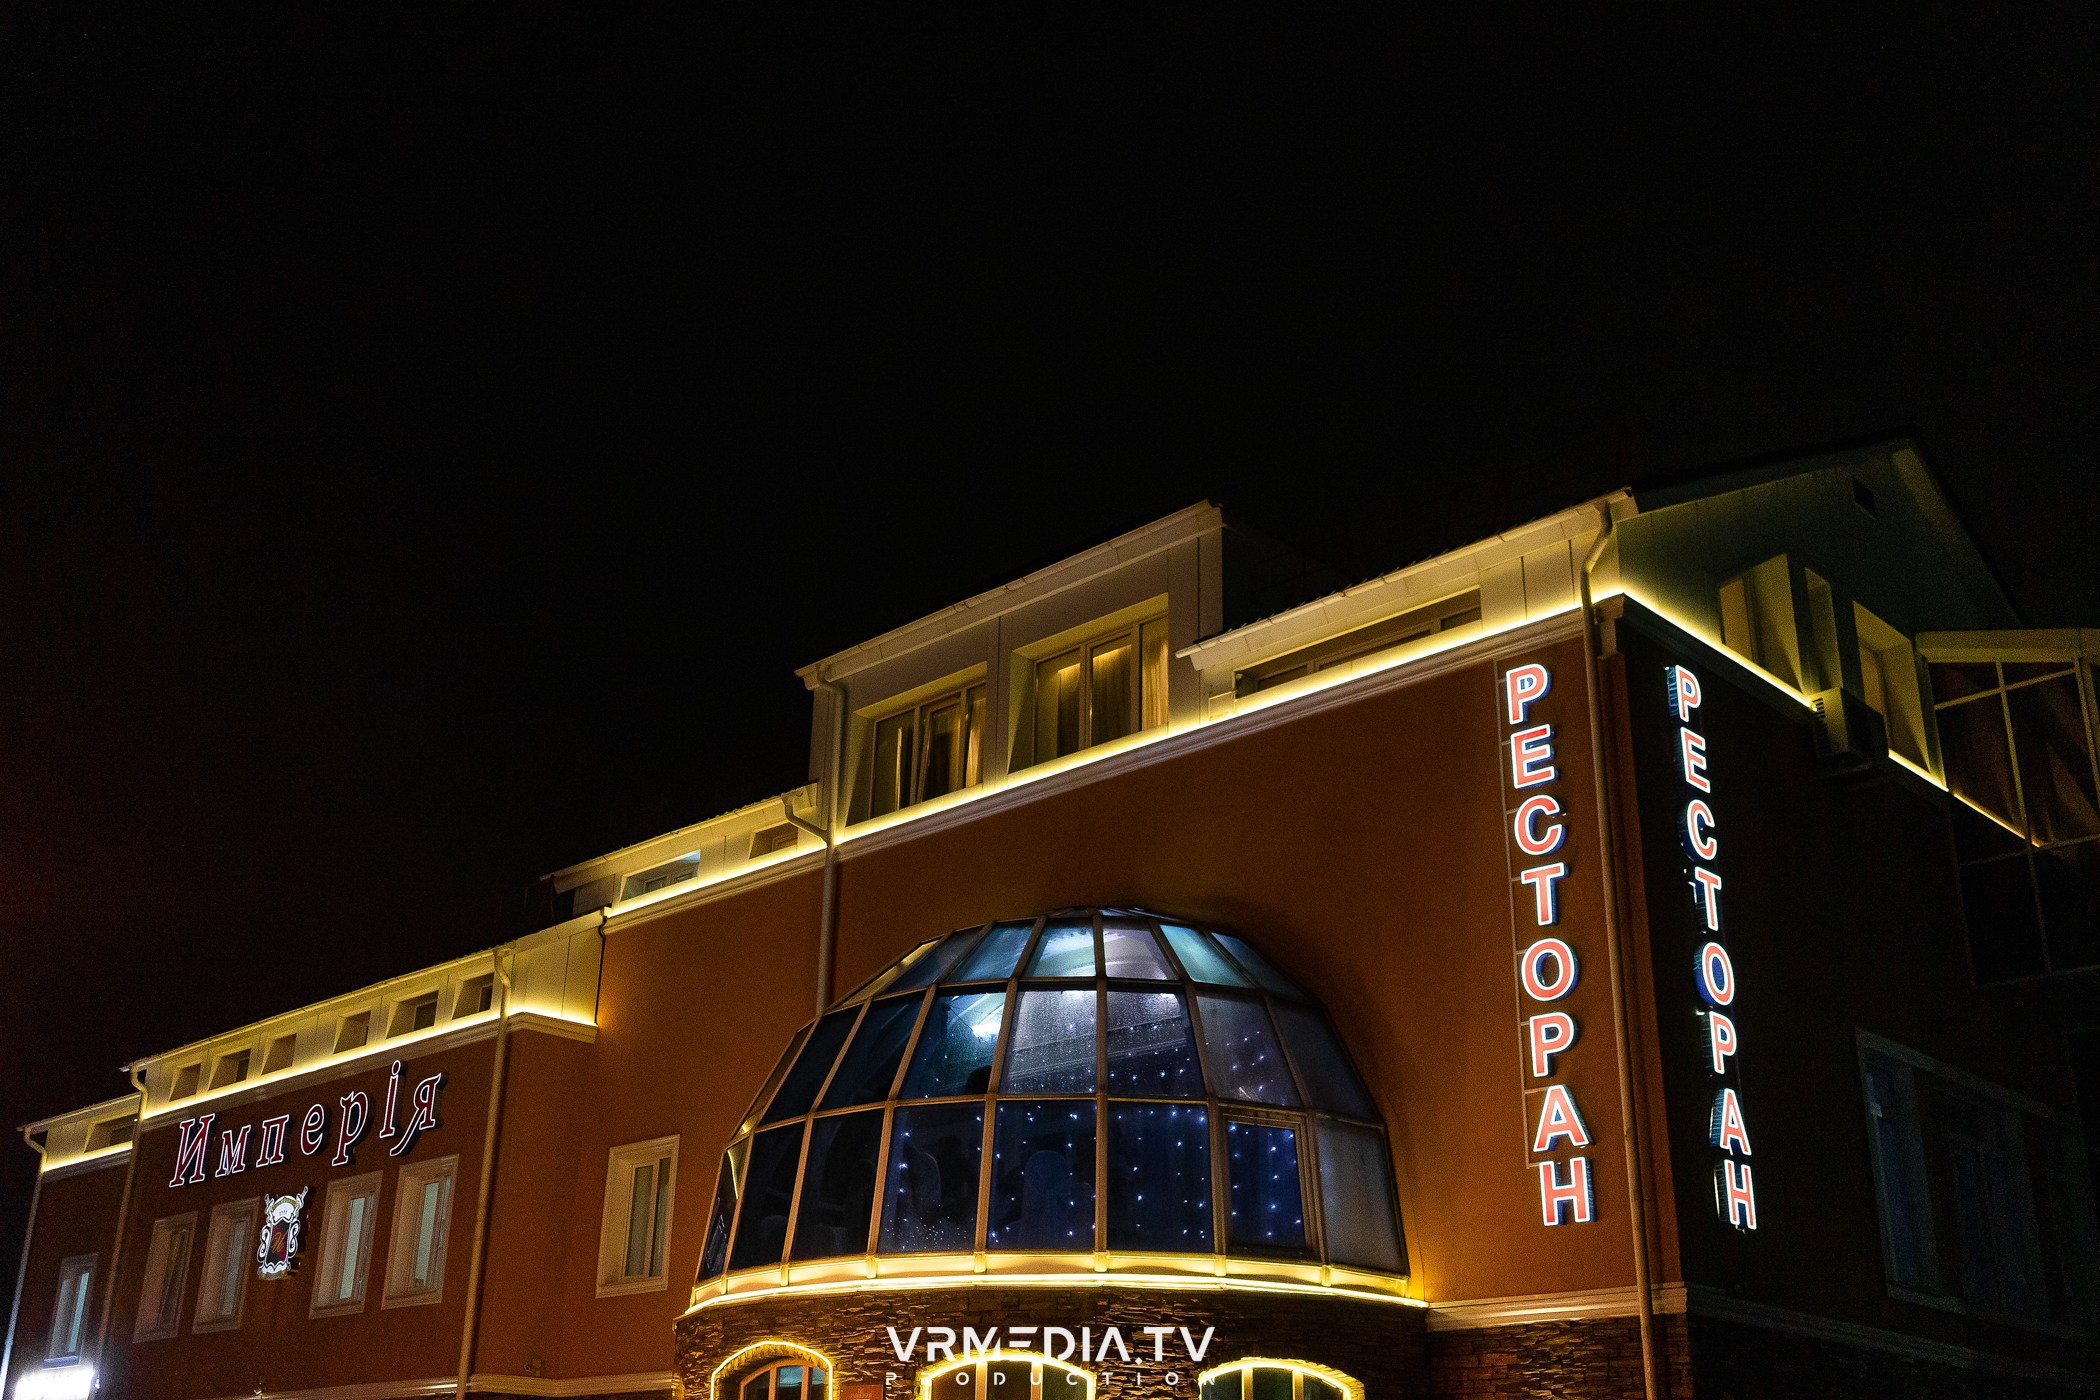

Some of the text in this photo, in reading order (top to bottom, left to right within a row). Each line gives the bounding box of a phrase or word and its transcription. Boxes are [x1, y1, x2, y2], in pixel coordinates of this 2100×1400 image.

[169, 1060, 442, 1188] Имперія
[1506, 663, 1592, 1226] РЕСТОРАН
[1674, 664, 1757, 1230] РЕСТОРАН
